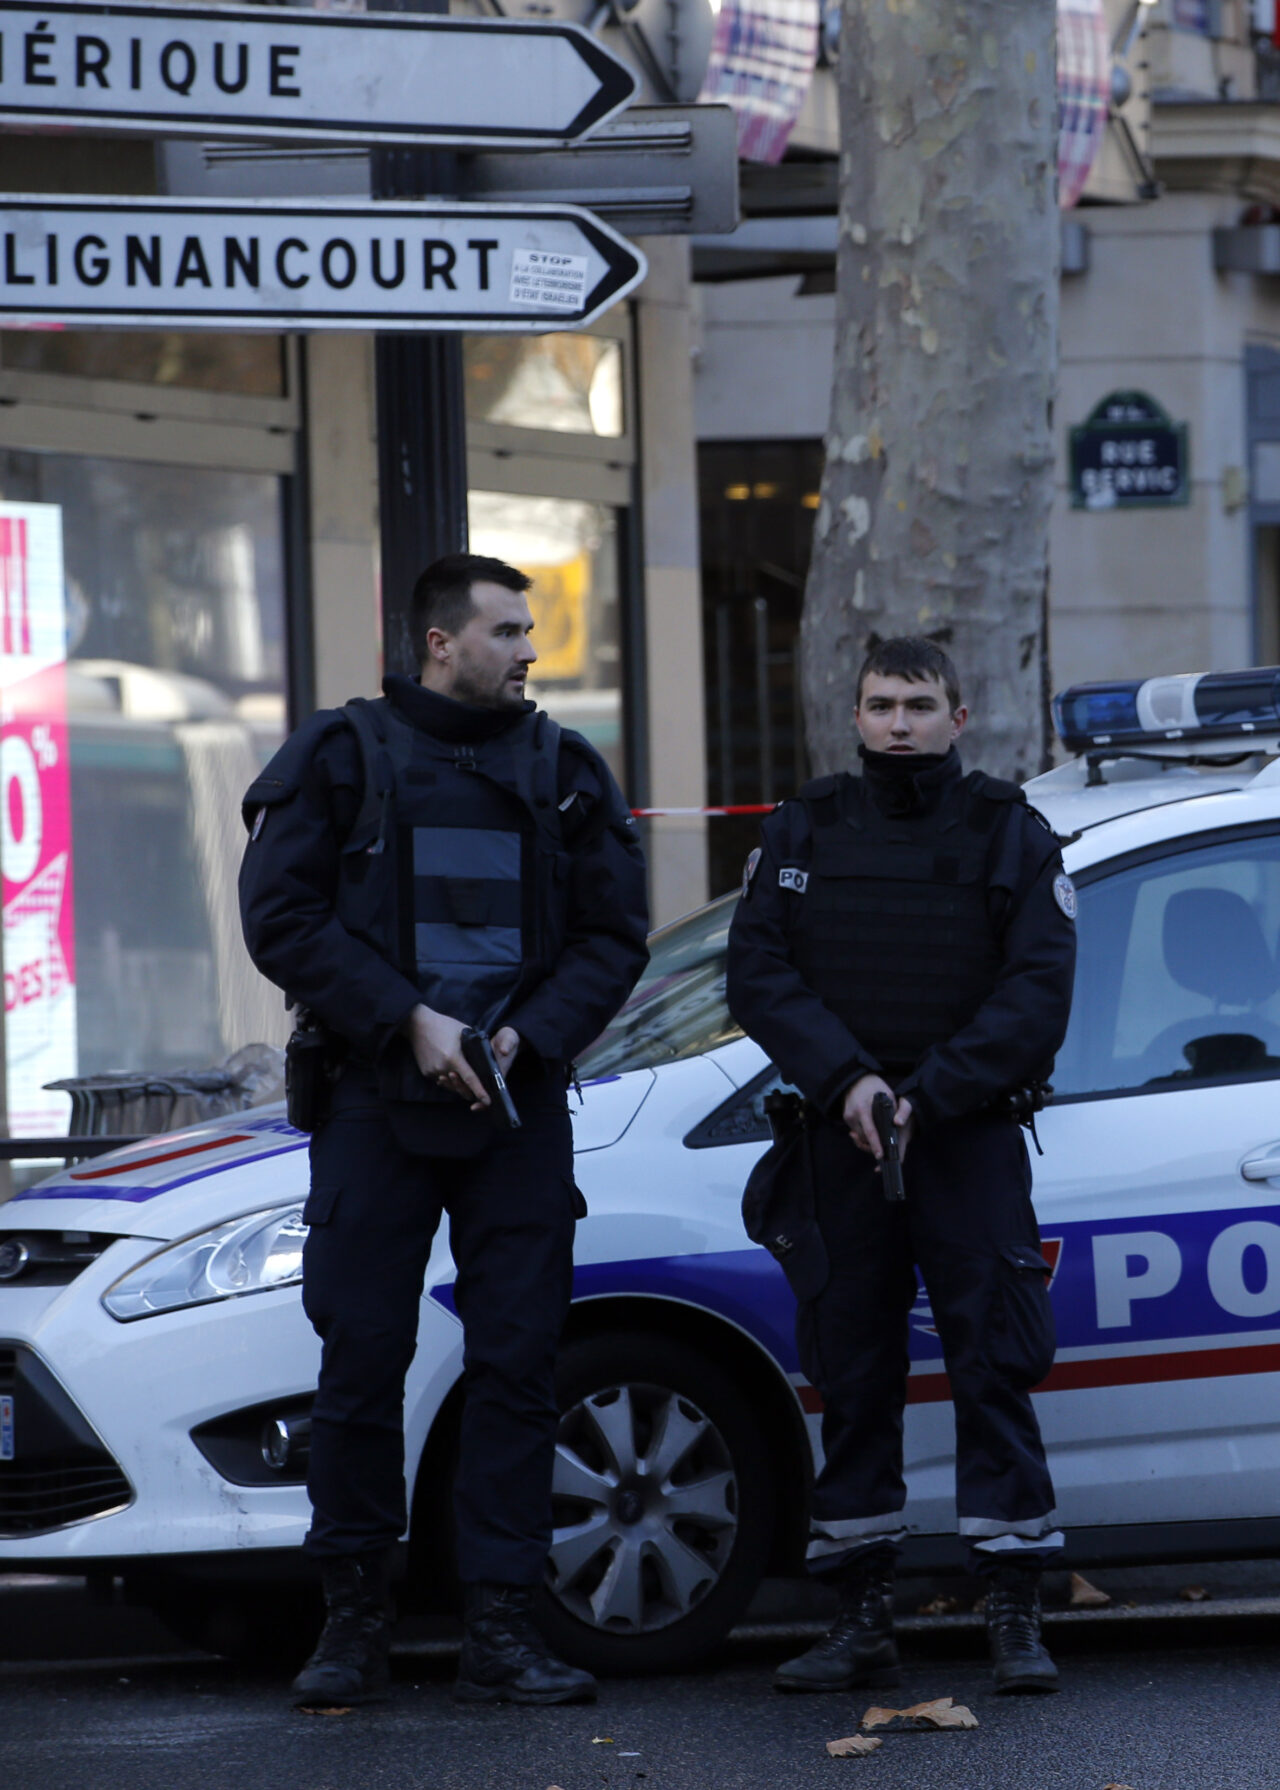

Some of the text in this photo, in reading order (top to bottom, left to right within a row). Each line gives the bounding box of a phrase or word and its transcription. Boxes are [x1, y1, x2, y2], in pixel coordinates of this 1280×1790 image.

[0, 21, 301, 97] ÉRIQUE
[5, 232, 500, 291] LIGNANCOURT
[529, 253, 572, 265] STOP
[1099, 439, 1158, 466] RUE
